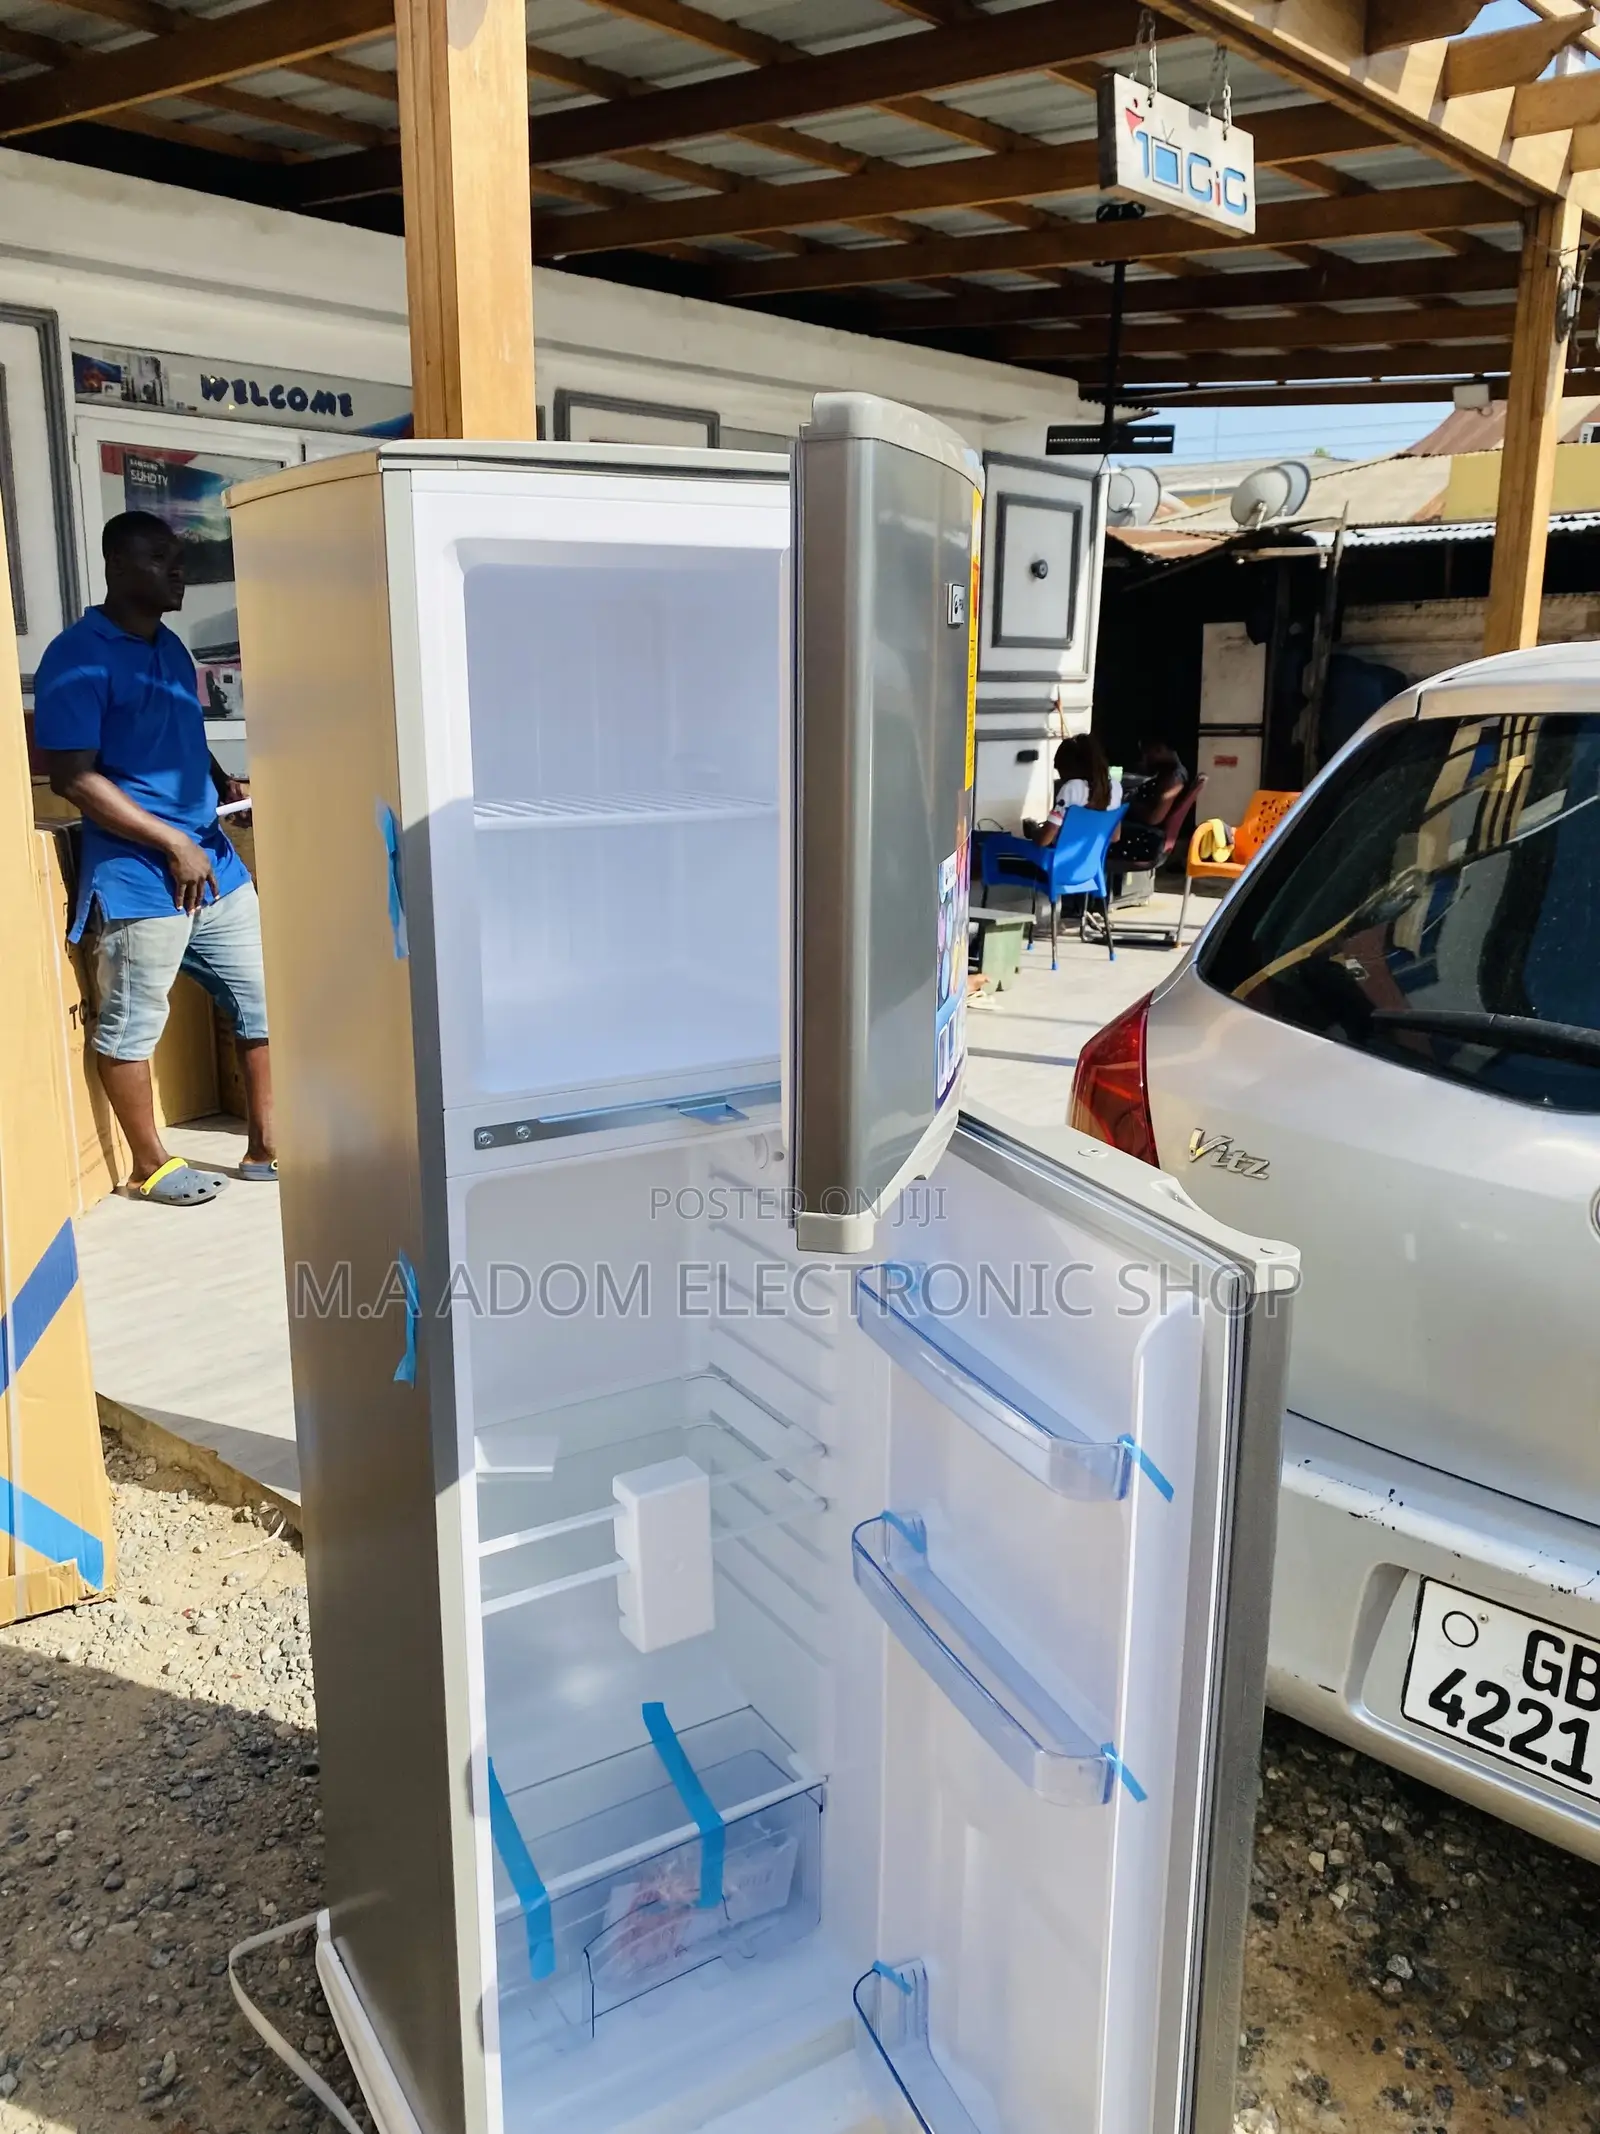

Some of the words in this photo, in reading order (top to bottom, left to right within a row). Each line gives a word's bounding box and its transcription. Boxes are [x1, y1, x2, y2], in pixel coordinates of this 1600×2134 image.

[200, 374, 354, 418] WELCOME
[1188, 1128, 1271, 1180] Vitz
[1522, 1629, 1600, 1712] GB
[1428, 1668, 1593, 1785] 4221
